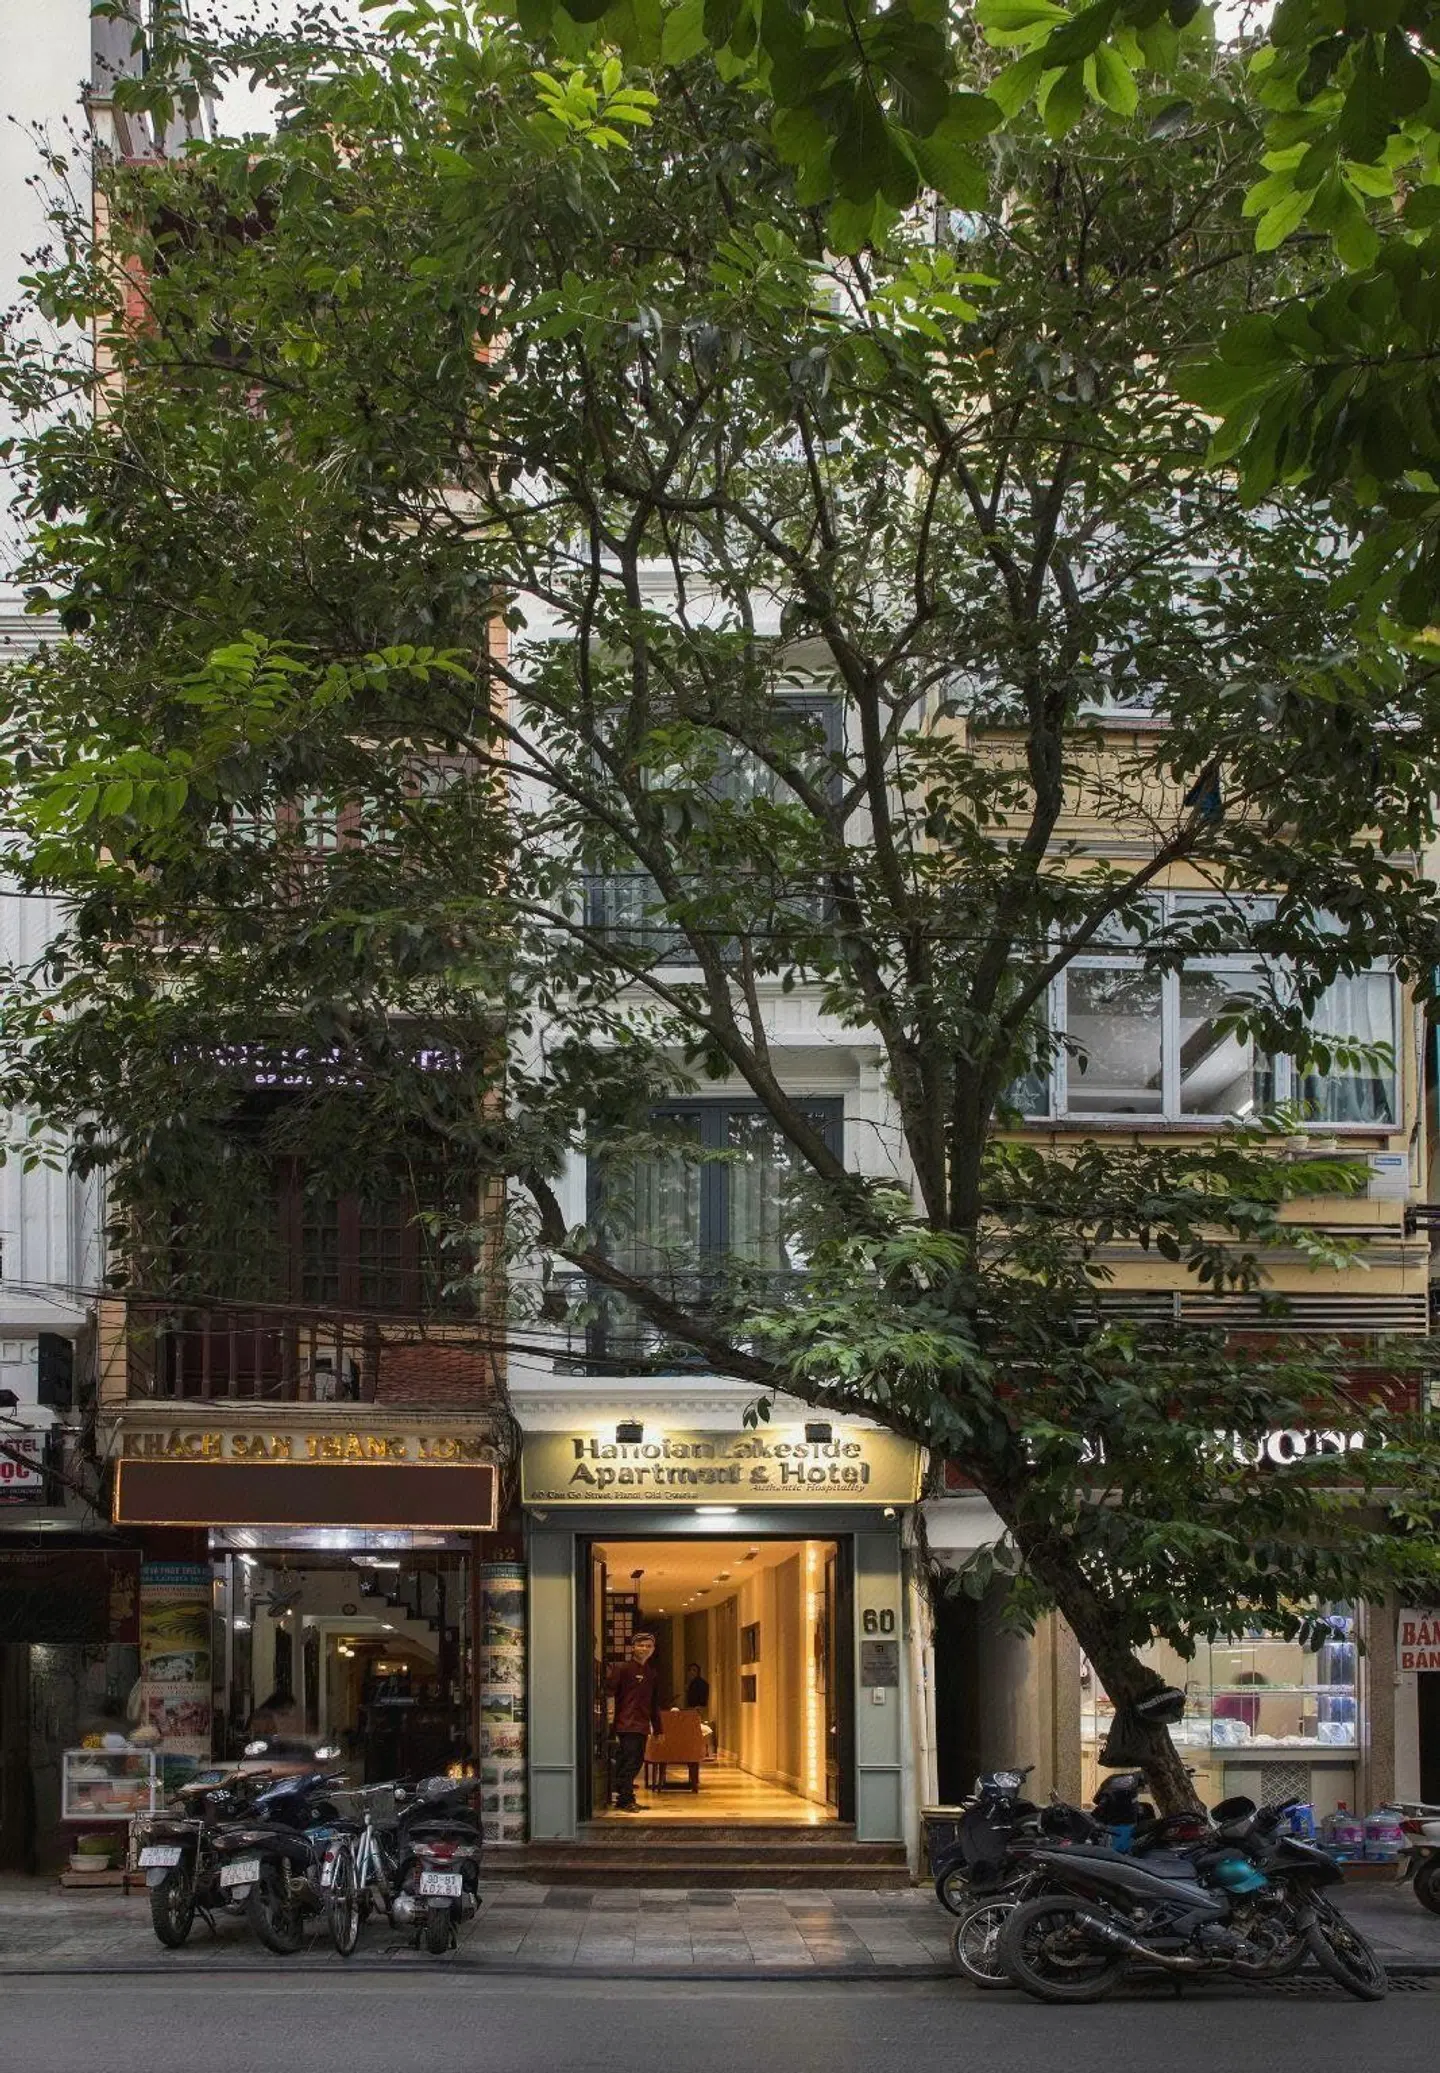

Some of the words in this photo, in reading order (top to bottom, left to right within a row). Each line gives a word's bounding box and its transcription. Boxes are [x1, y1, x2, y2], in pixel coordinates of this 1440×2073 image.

[123, 1428, 223, 1457] KHÁCH
[572, 1438, 715, 1459] Hanoian
[568, 1462, 741, 1489] Apartment
[750, 1465, 770, 1484] &
[779, 1462, 871, 1484] Hotel
[806, 1483, 866, 1493] Hospitality
[863, 1608, 895, 1635] 60
